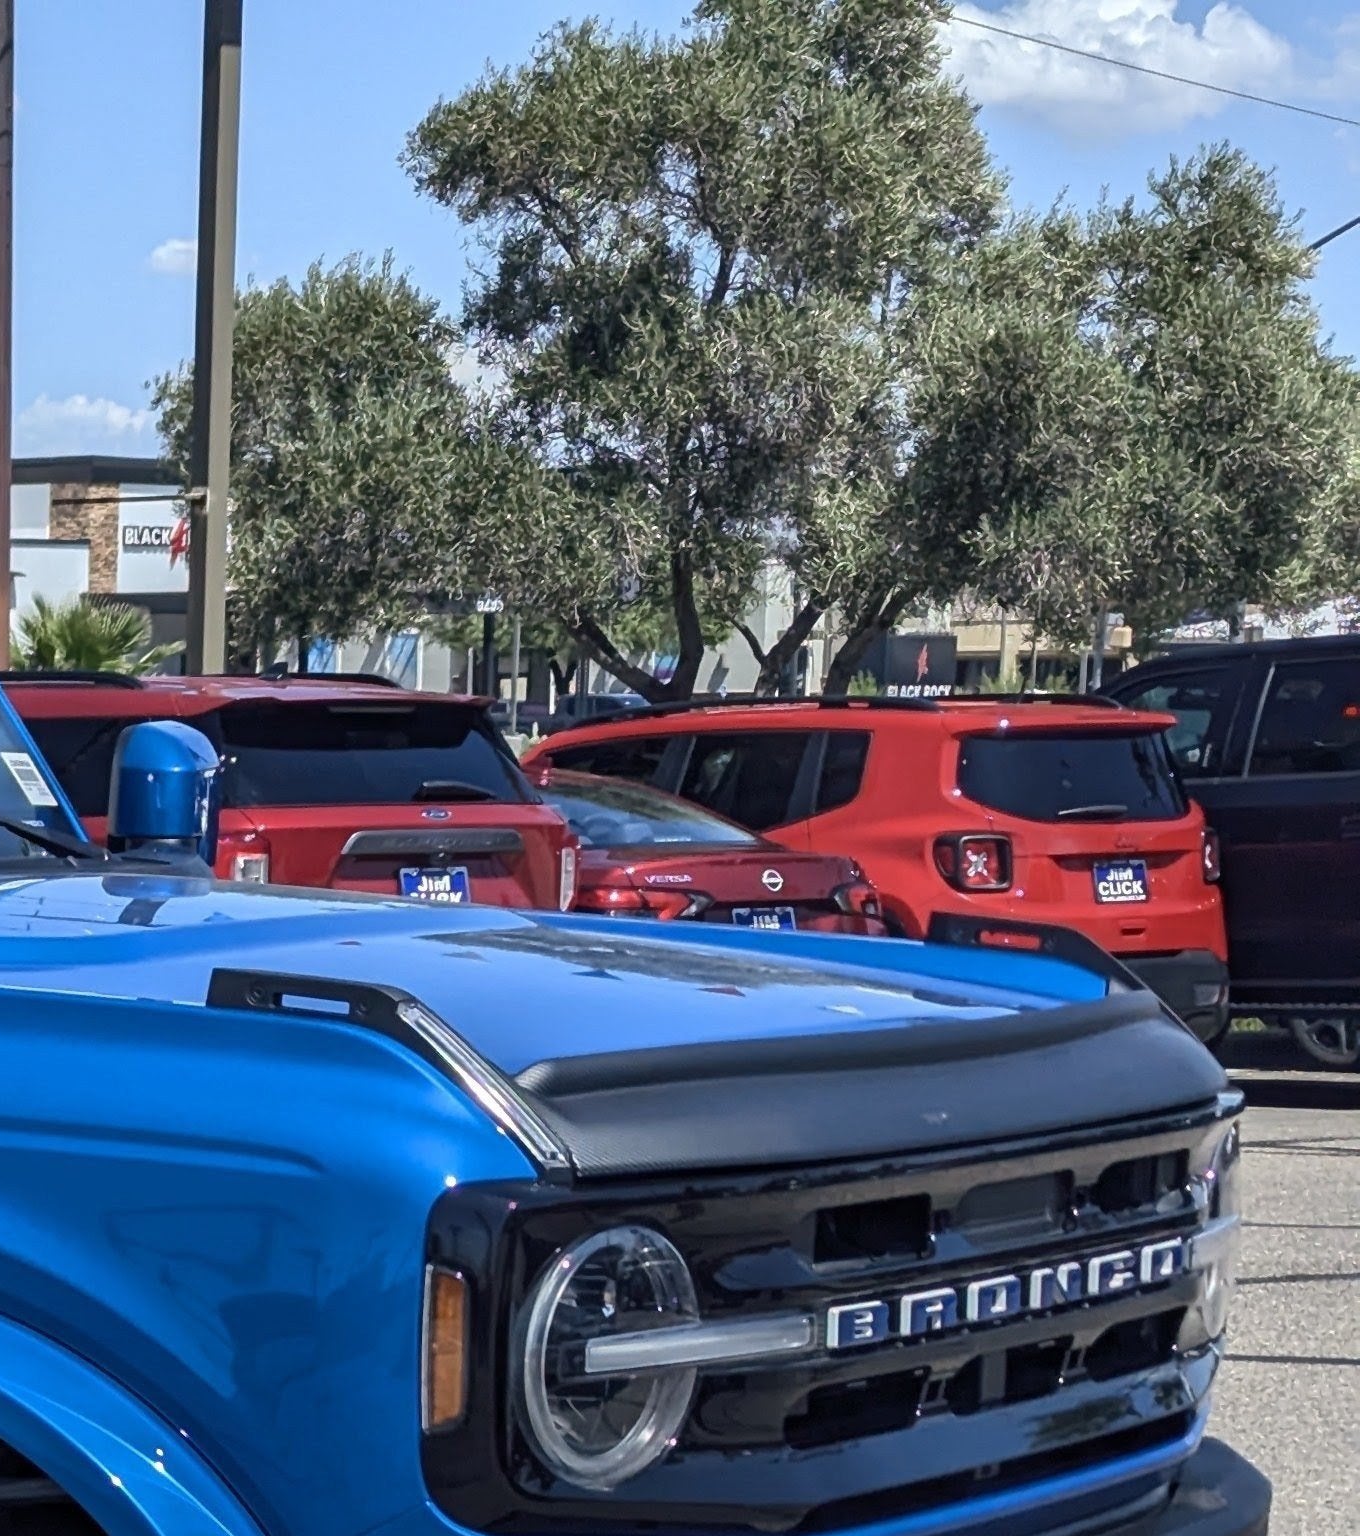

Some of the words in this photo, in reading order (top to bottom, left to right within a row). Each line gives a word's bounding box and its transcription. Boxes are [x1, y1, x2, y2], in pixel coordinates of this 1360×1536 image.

[124, 526, 171, 546] BLACK
[644, 873, 693, 883] VERSA
[1105, 866, 1133, 881] JIM
[417, 874, 451, 892] JIM
[1098, 880, 1144, 896] CLICK
[825, 1237, 1184, 1350] BRONCO
